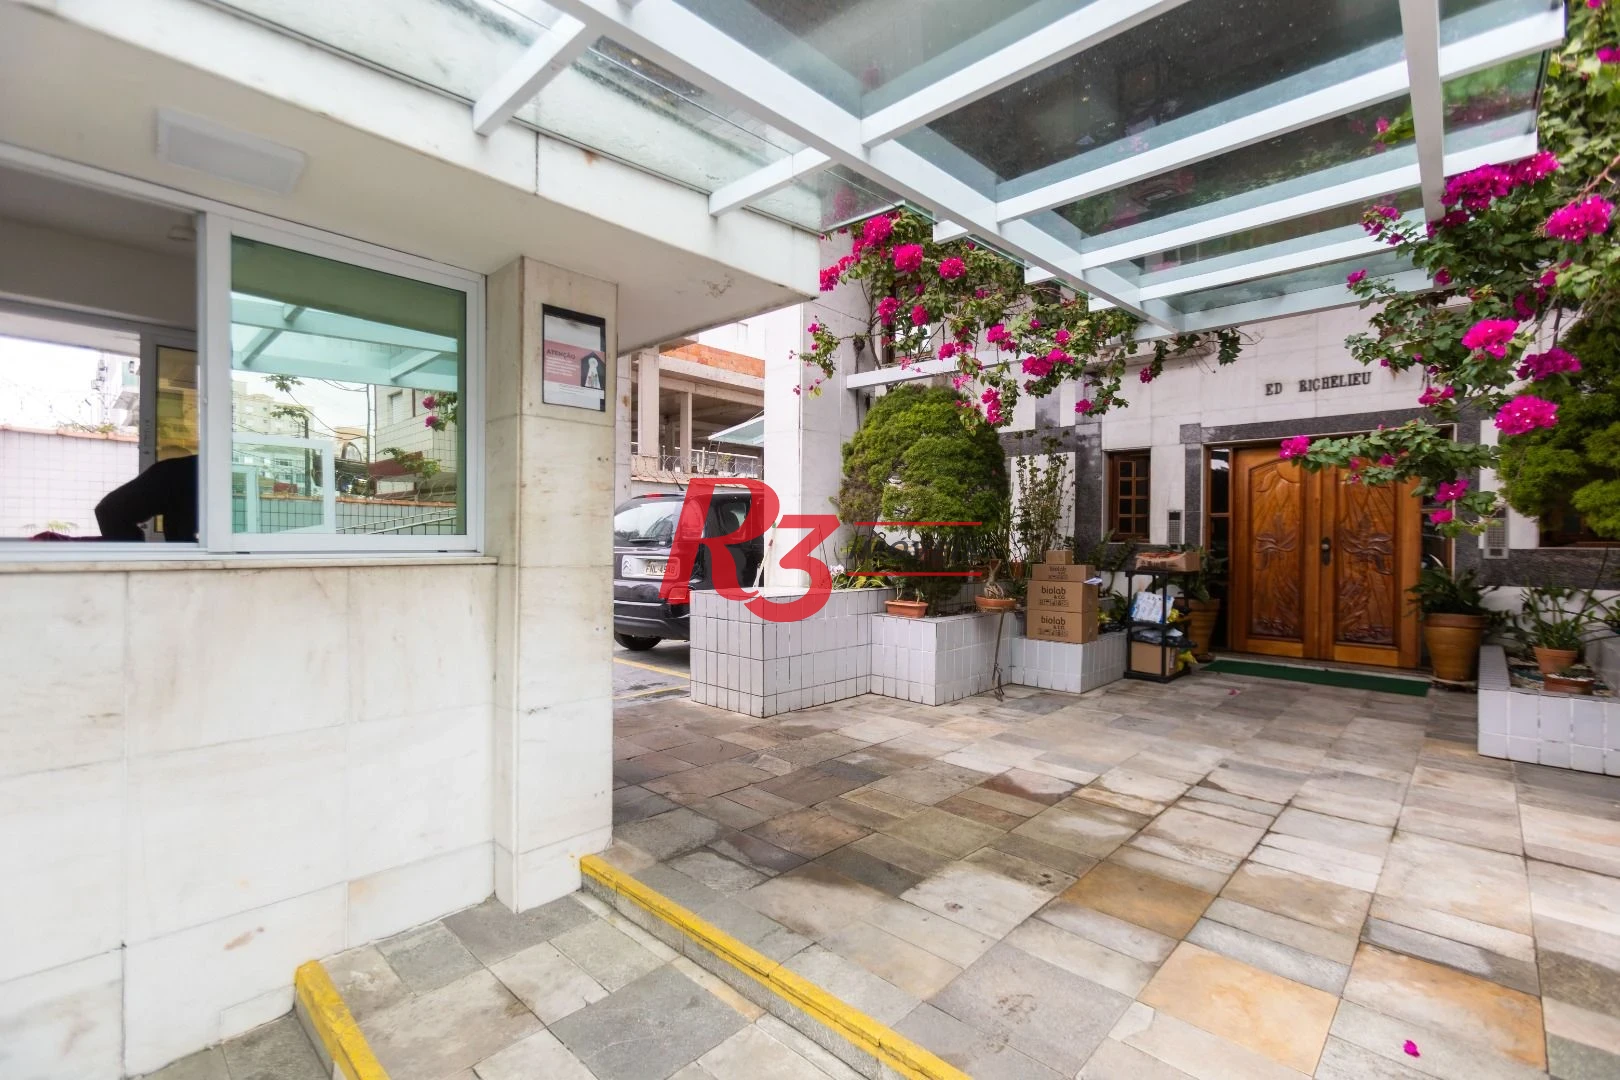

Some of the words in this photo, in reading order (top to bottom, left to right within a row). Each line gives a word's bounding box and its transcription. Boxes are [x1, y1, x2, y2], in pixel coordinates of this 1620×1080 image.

[546, 348, 576, 360] ATENÇÃO
[1265, 382, 1283, 396] ED
[1041, 585, 1066, 595] biolab
[1040, 615, 1066, 626] biolab
